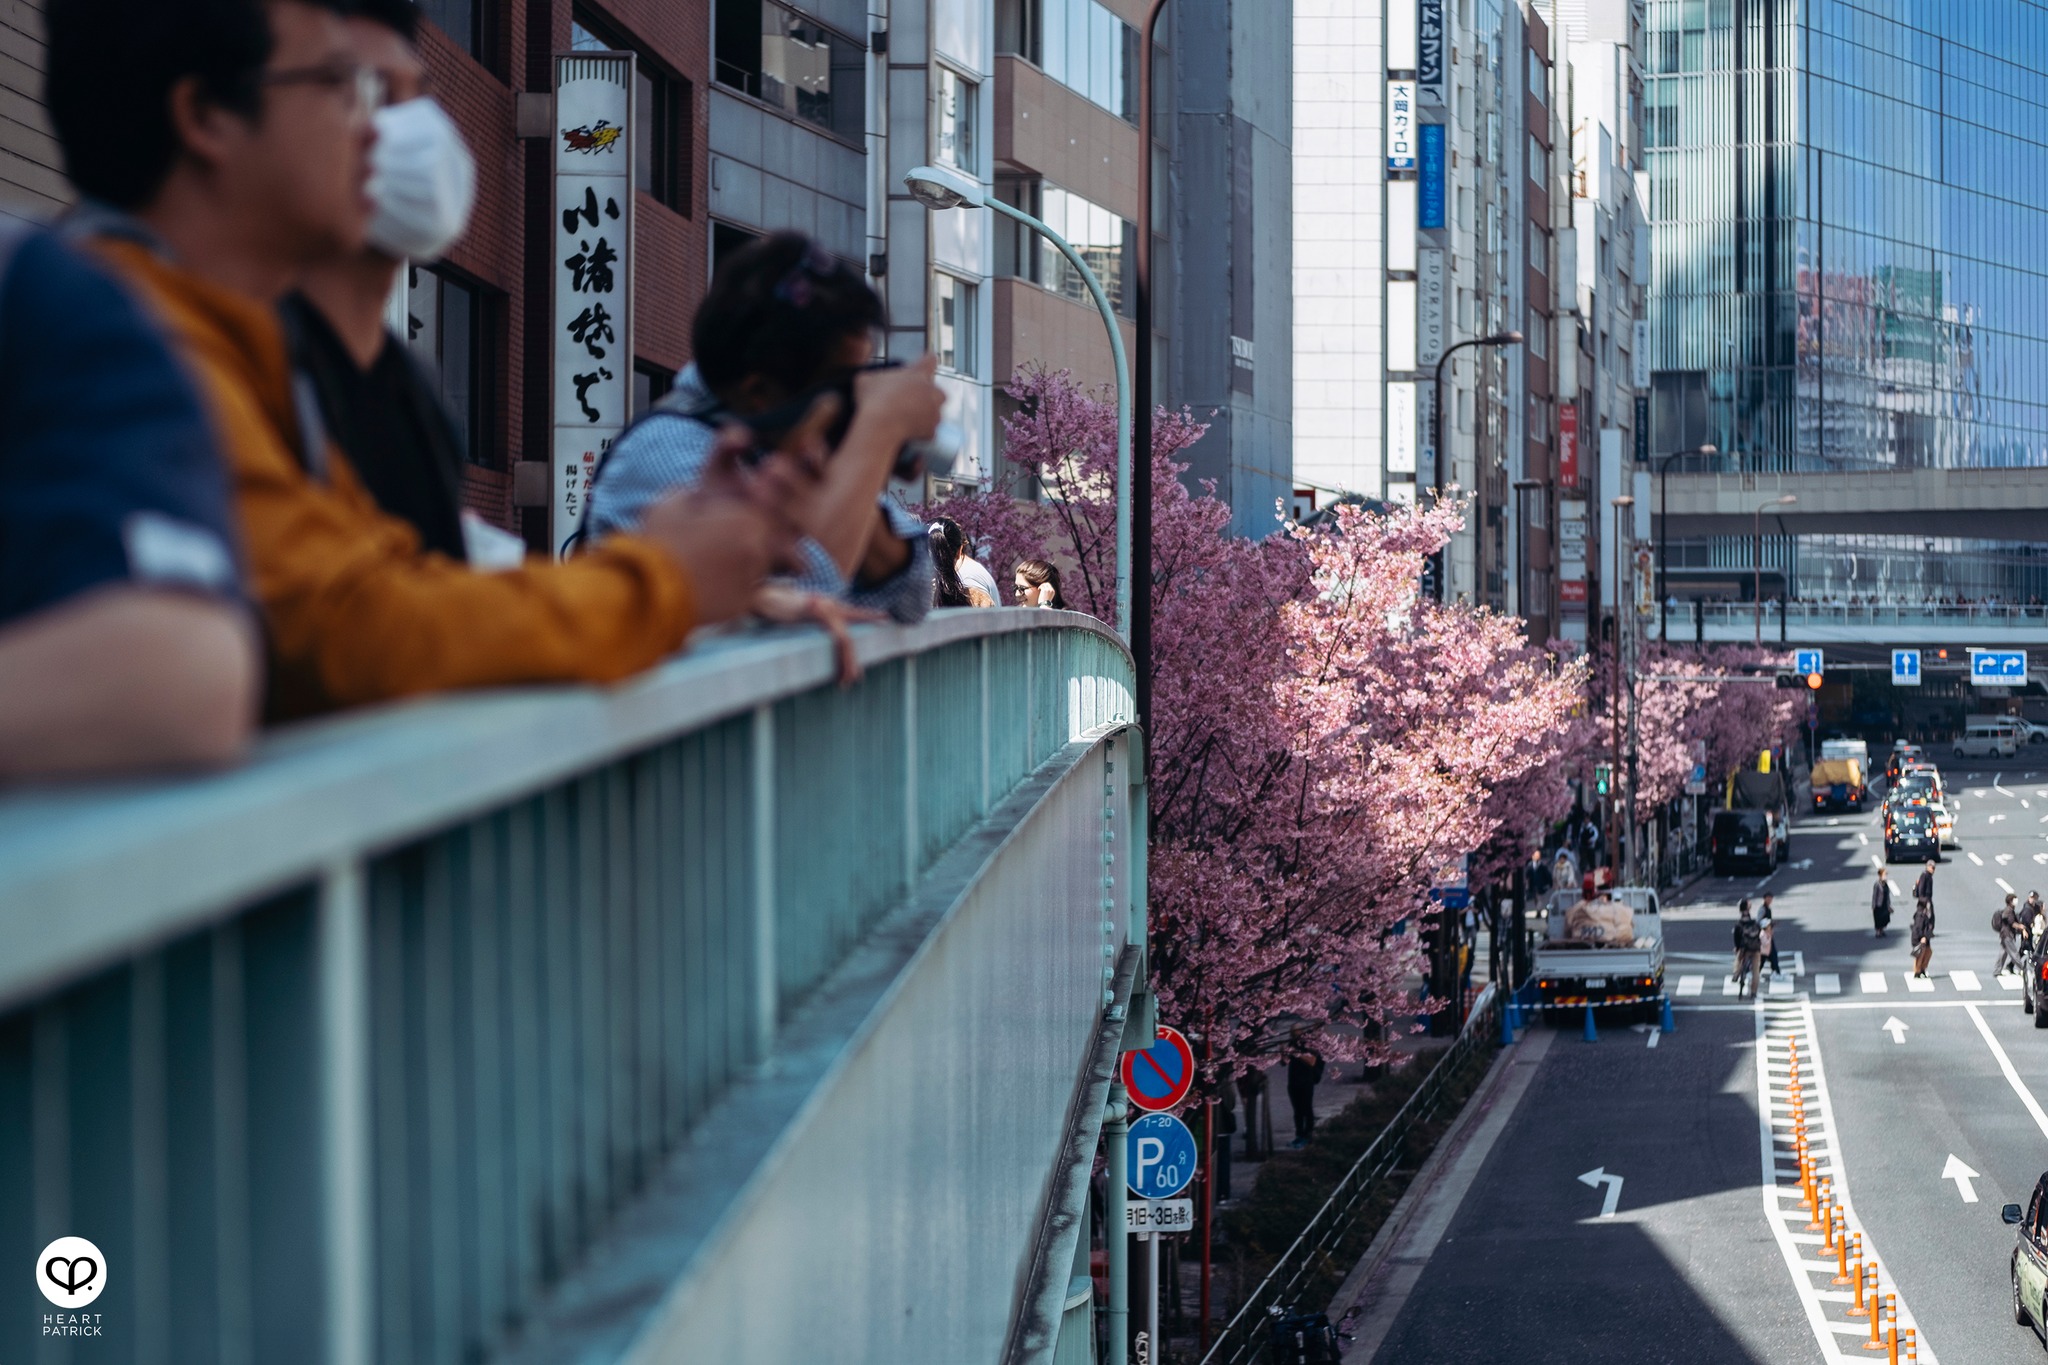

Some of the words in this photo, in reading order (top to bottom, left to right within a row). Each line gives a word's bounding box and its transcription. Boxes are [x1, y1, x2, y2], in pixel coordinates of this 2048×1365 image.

[1420, 0, 1440, 80] ドルフィン
[1393, 85, 1408, 153] 大岡カイロ
[566, 464, 578, 517] 揚げたて
[1143, 1117, 1173, 1128] 7-20
[1137, 1137, 1165, 1189] P
[1156, 1164, 1179, 1188] 60
